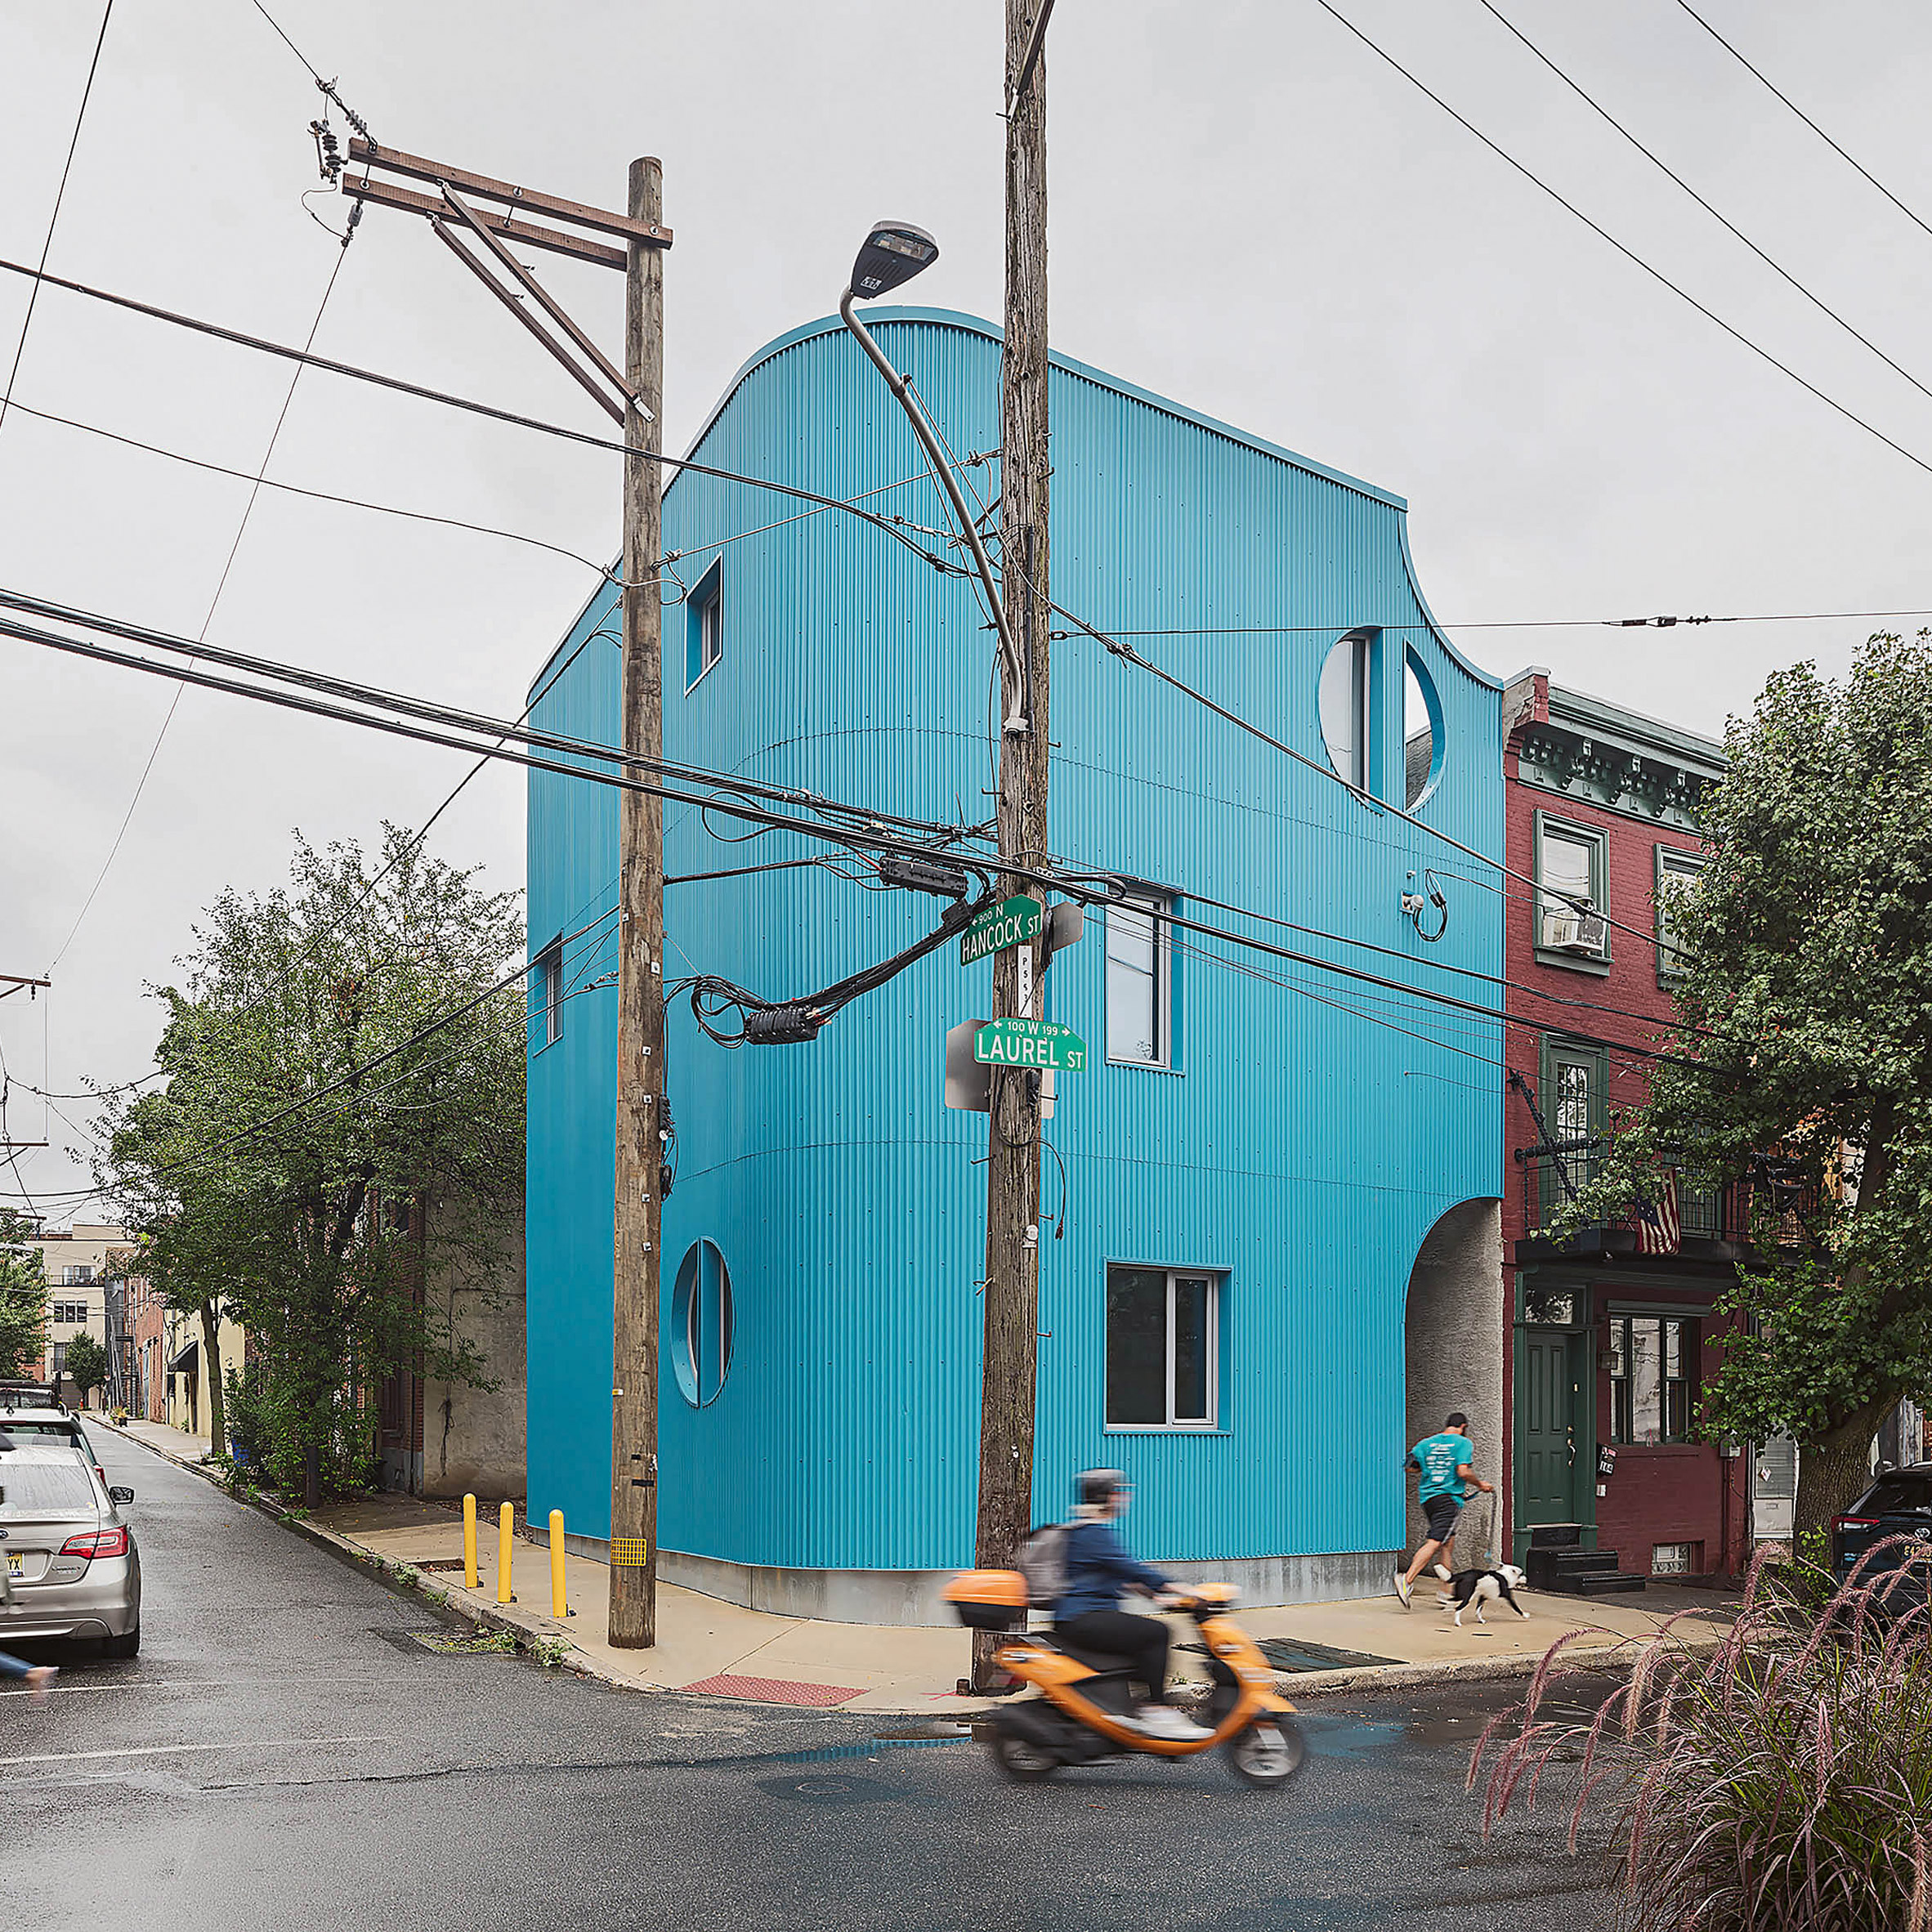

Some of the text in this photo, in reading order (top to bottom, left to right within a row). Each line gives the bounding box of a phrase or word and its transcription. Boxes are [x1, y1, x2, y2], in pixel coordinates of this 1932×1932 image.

[978, 903, 1004, 924] 900 N
[962, 913, 1040, 963] HANCOCK ST
[1007, 1021, 1058, 1036] 100 W 199
[977, 1032, 1084, 1069] LAUREL ST
